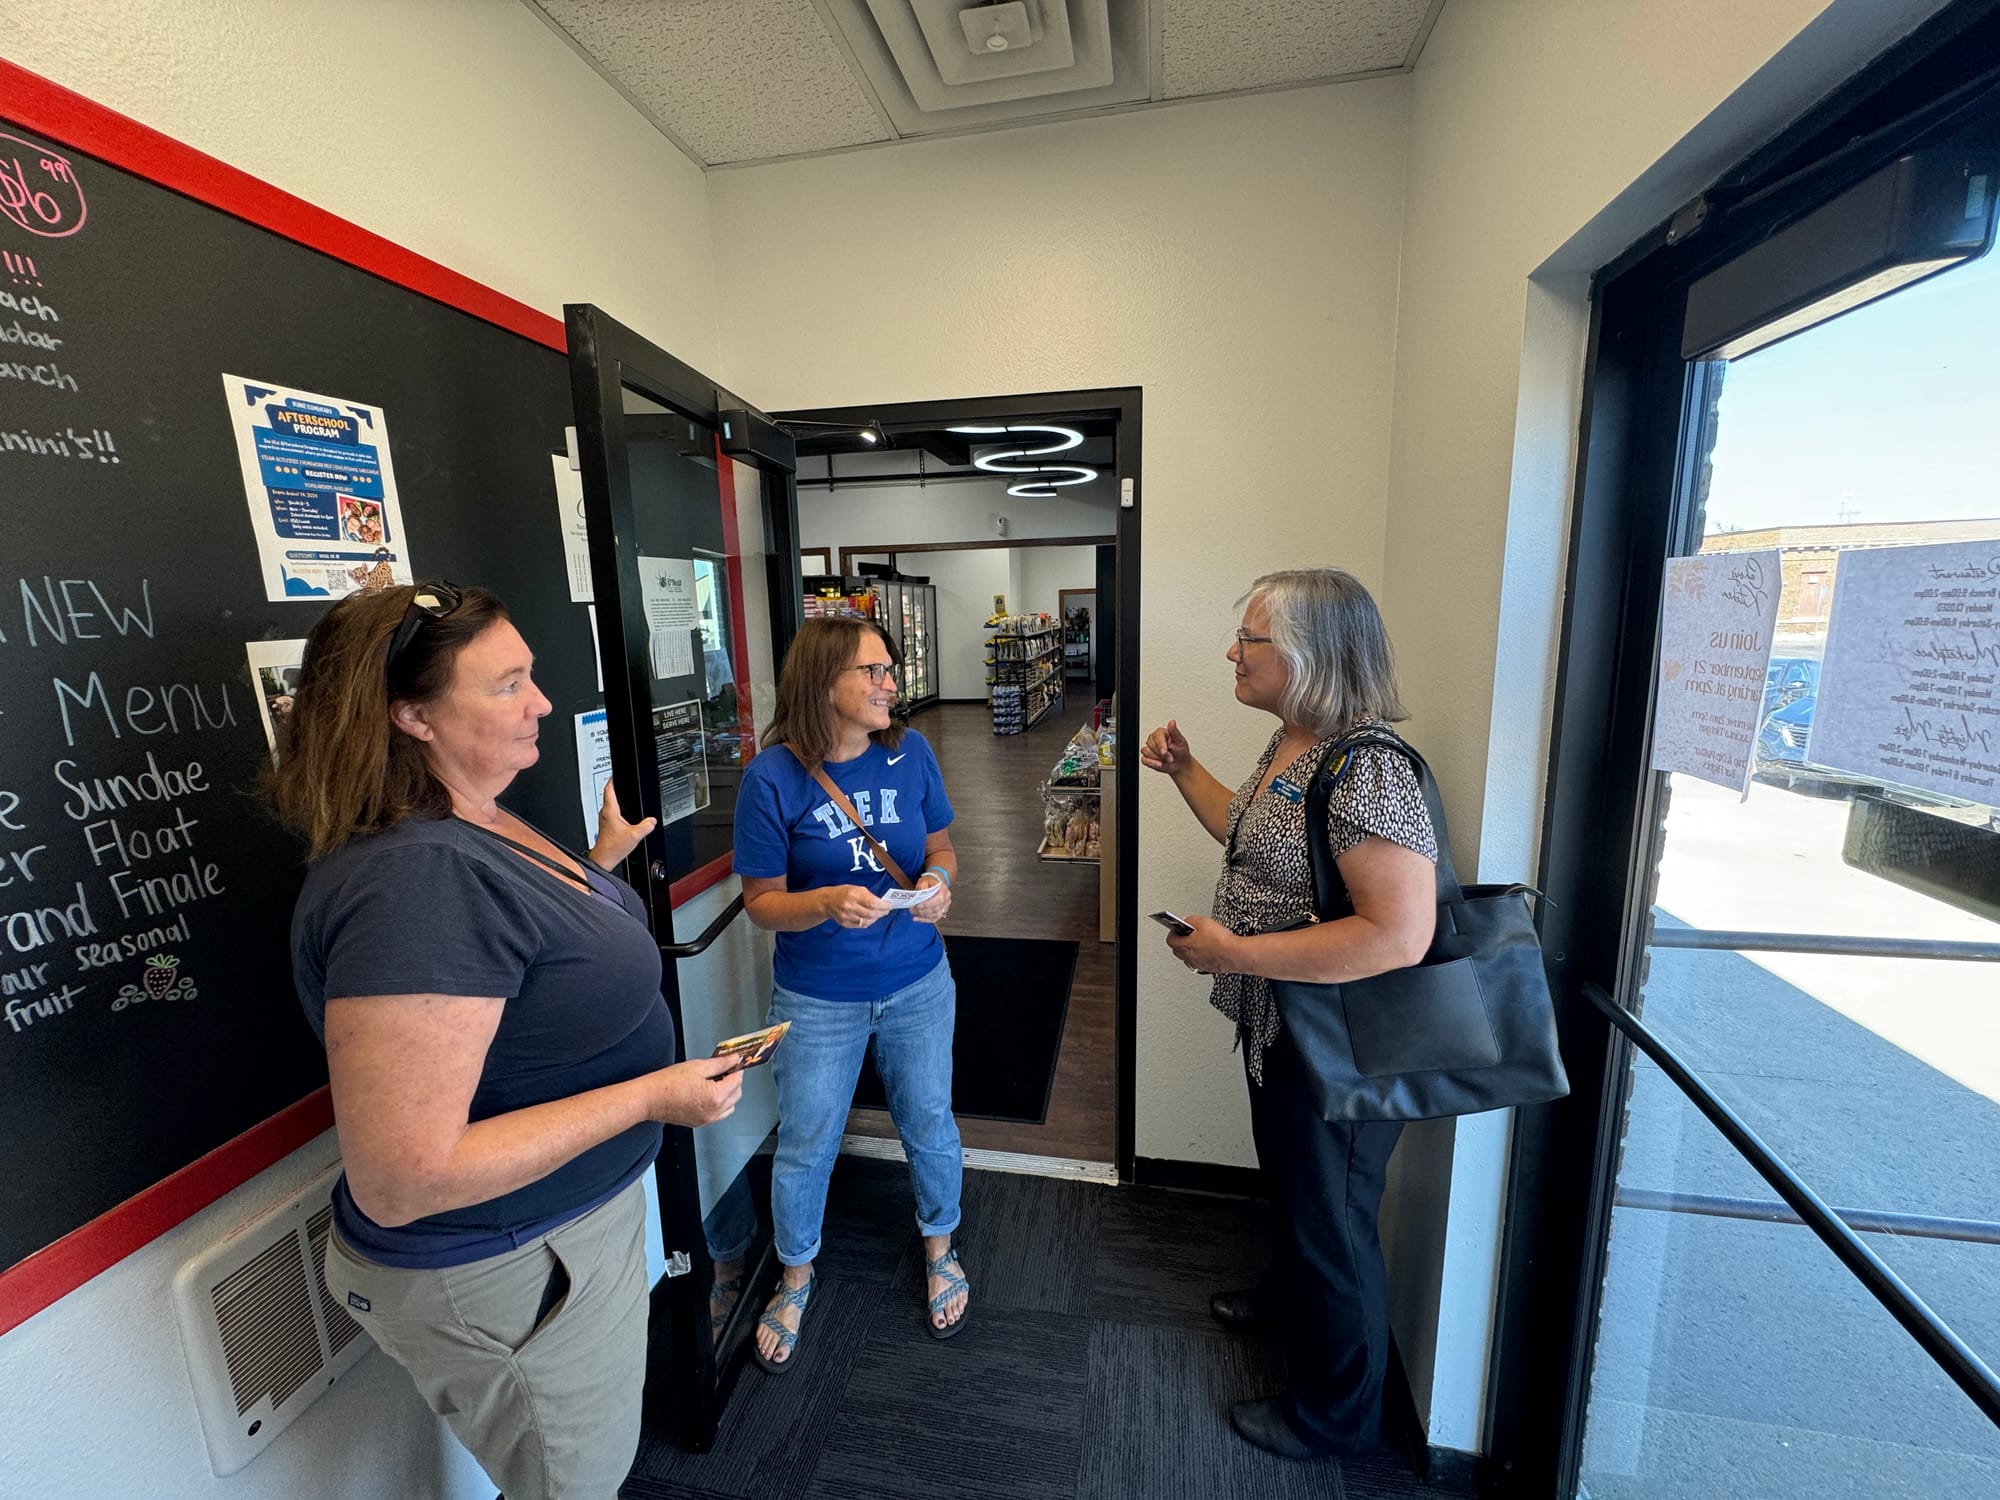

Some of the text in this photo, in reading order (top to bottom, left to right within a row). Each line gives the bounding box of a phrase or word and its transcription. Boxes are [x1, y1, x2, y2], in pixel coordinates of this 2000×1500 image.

[0, 320, 63, 351] dar
[0, 427, 119, 463] nini's!!
[277, 411, 352, 431] AFTERSCHOOL
[293, 423, 340, 439] PROGRAM
[19, 575, 154, 648] NEW
[53, 671, 238, 747] Menu
[54, 751, 209, 821] Sundae
[879, 789, 900, 824] K
[83, 807, 199, 868] Float
[0, 856, 226, 953] and Finale
[75, 913, 192, 972] seasonal
[3, 984, 87, 1034] fruit
